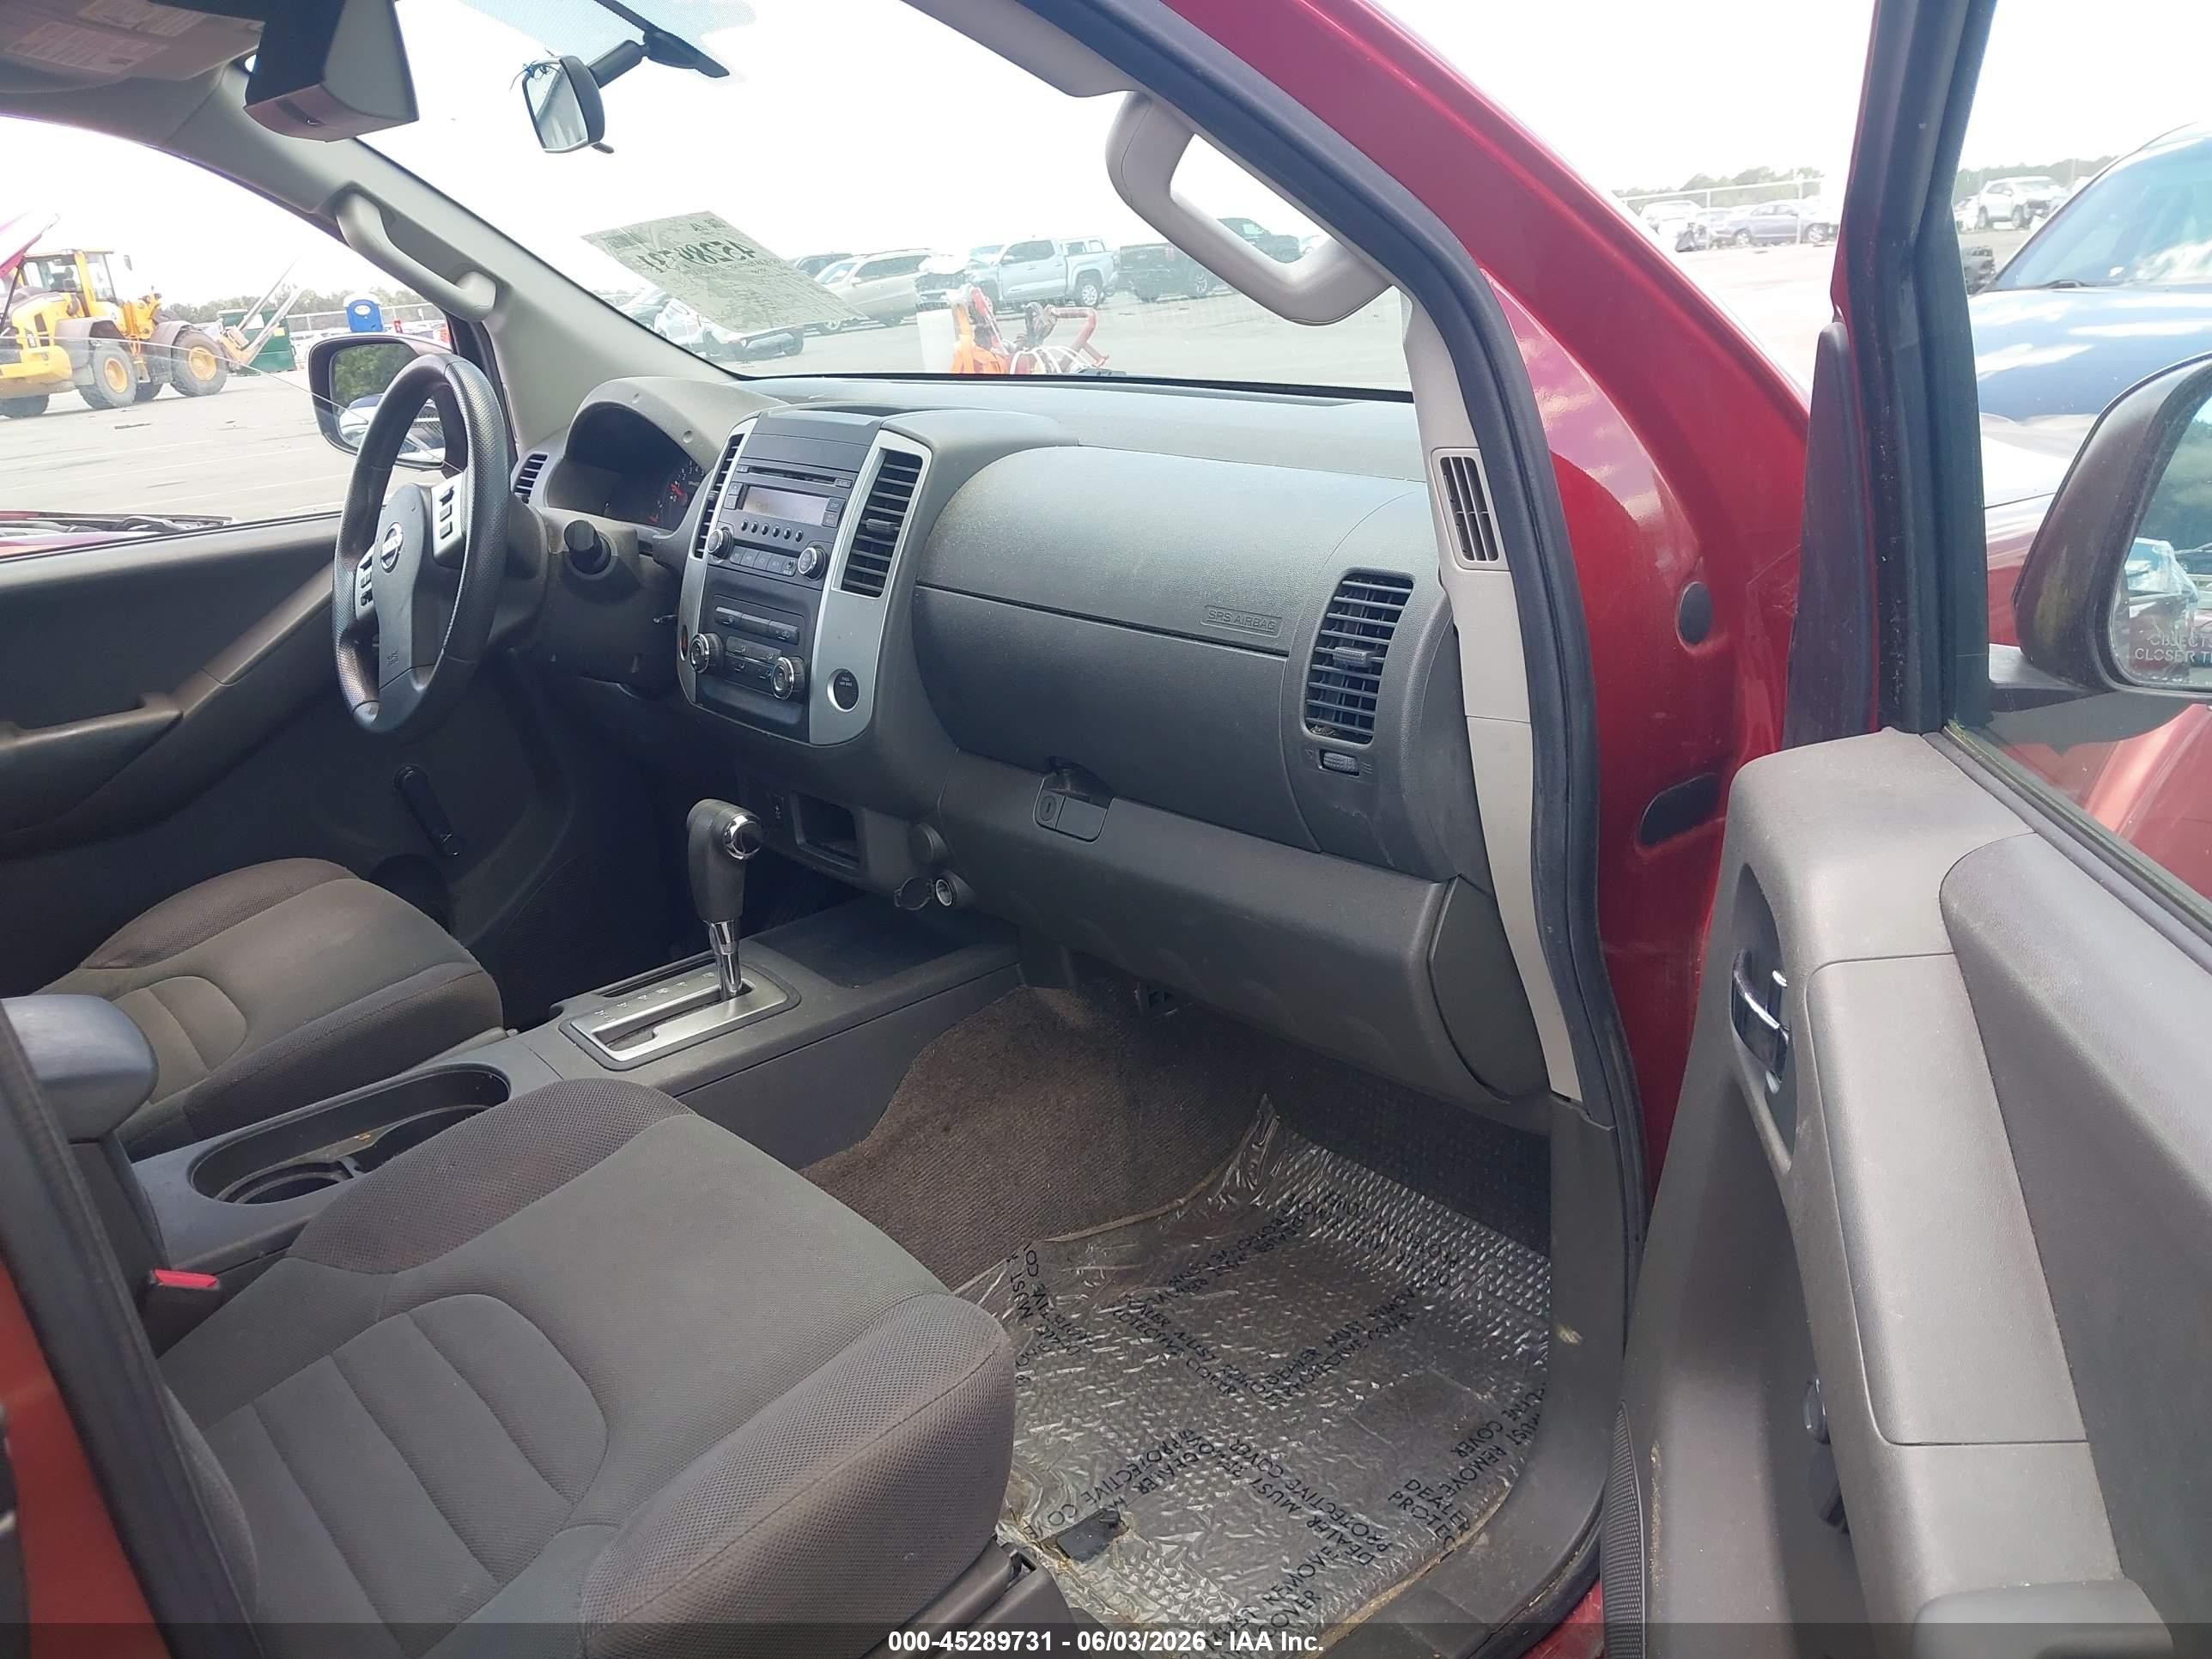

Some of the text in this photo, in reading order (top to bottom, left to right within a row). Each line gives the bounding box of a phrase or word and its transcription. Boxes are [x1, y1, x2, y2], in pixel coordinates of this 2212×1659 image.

[1208, 609, 1277, 629] SRS AIRBAG
[2135, 647, 2196, 663] CLOSER
[1450, 1420, 1503, 1458] COVER
[1249, 1476, 1303, 1515] MUST
[1437, 1444, 1508, 1497] REMOVE
[1285, 1478, 1393, 1553] PROTECTIVE
[1404, 1479, 1471, 1537] DEALER
[1306, 1515, 1375, 1565] DEALER
[1261, 1546, 1339, 1607] REMOVE
